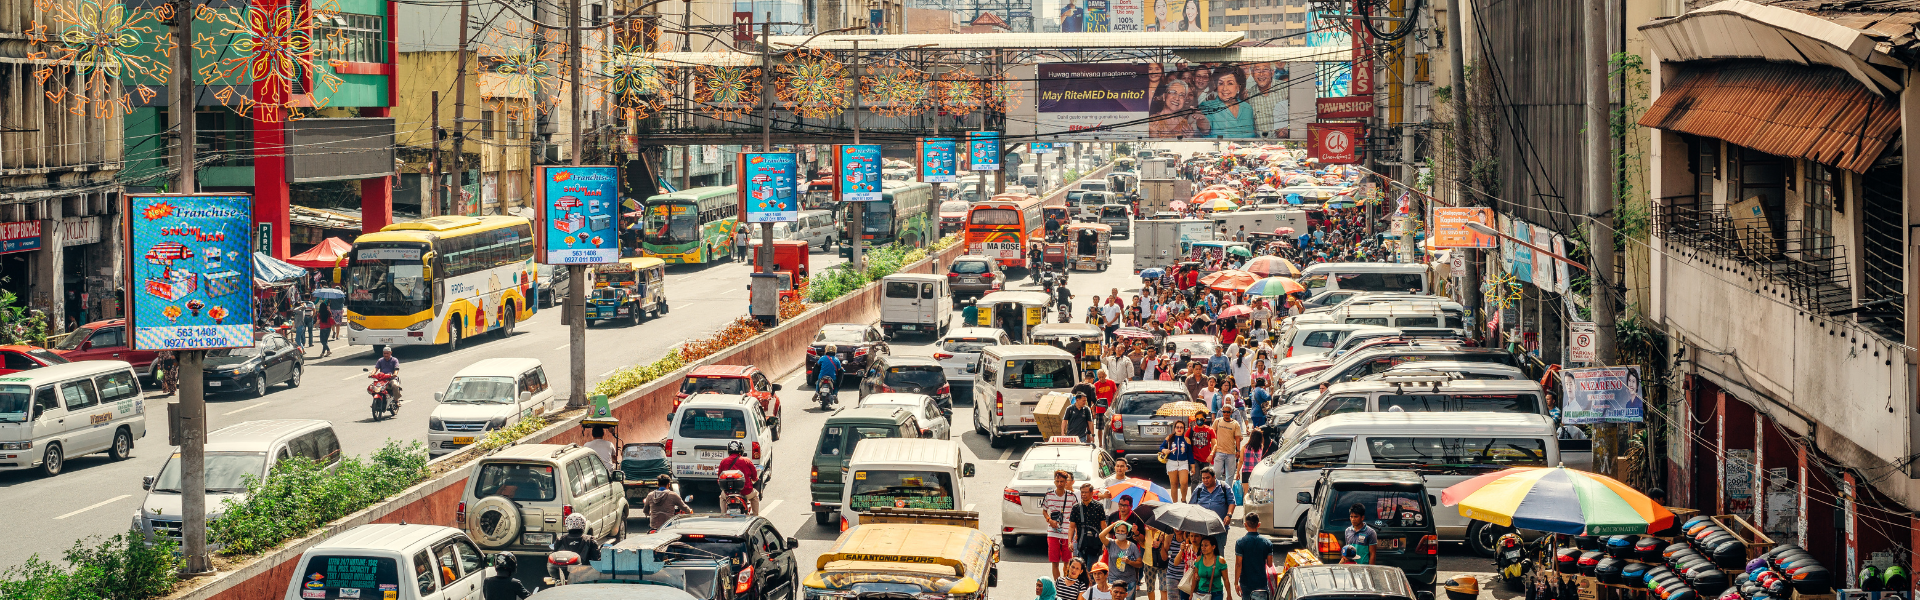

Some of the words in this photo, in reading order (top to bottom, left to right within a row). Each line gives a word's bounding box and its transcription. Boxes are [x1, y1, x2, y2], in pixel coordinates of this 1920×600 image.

[1042, 90, 1062, 102] May
[1064, 90, 1105, 100] RiteMED
[1106, 90, 1119, 99] ba
[1120, 90, 1145, 99] nito?
[1317, 101, 1373, 114] PAWNSHOP
[1328, 134, 1345, 150] Ck
[176, 207, 236, 218] Franchise
[161, 222, 200, 237] SNOW
[196, 232, 225, 242] MAN
[177, 328, 193, 337] 563
[196, 328, 217, 337] 1408
[164, 338, 186, 348] 0927
[188, 338, 203, 347] 011
[206, 337, 228, 347] 8000
[1580, 379, 1622, 391] NAZARENO
[1601, 525, 1639, 534] MICROMATIC
[863, 554, 899, 562] ANTONIO
[900, 556, 934, 564] SPURS
